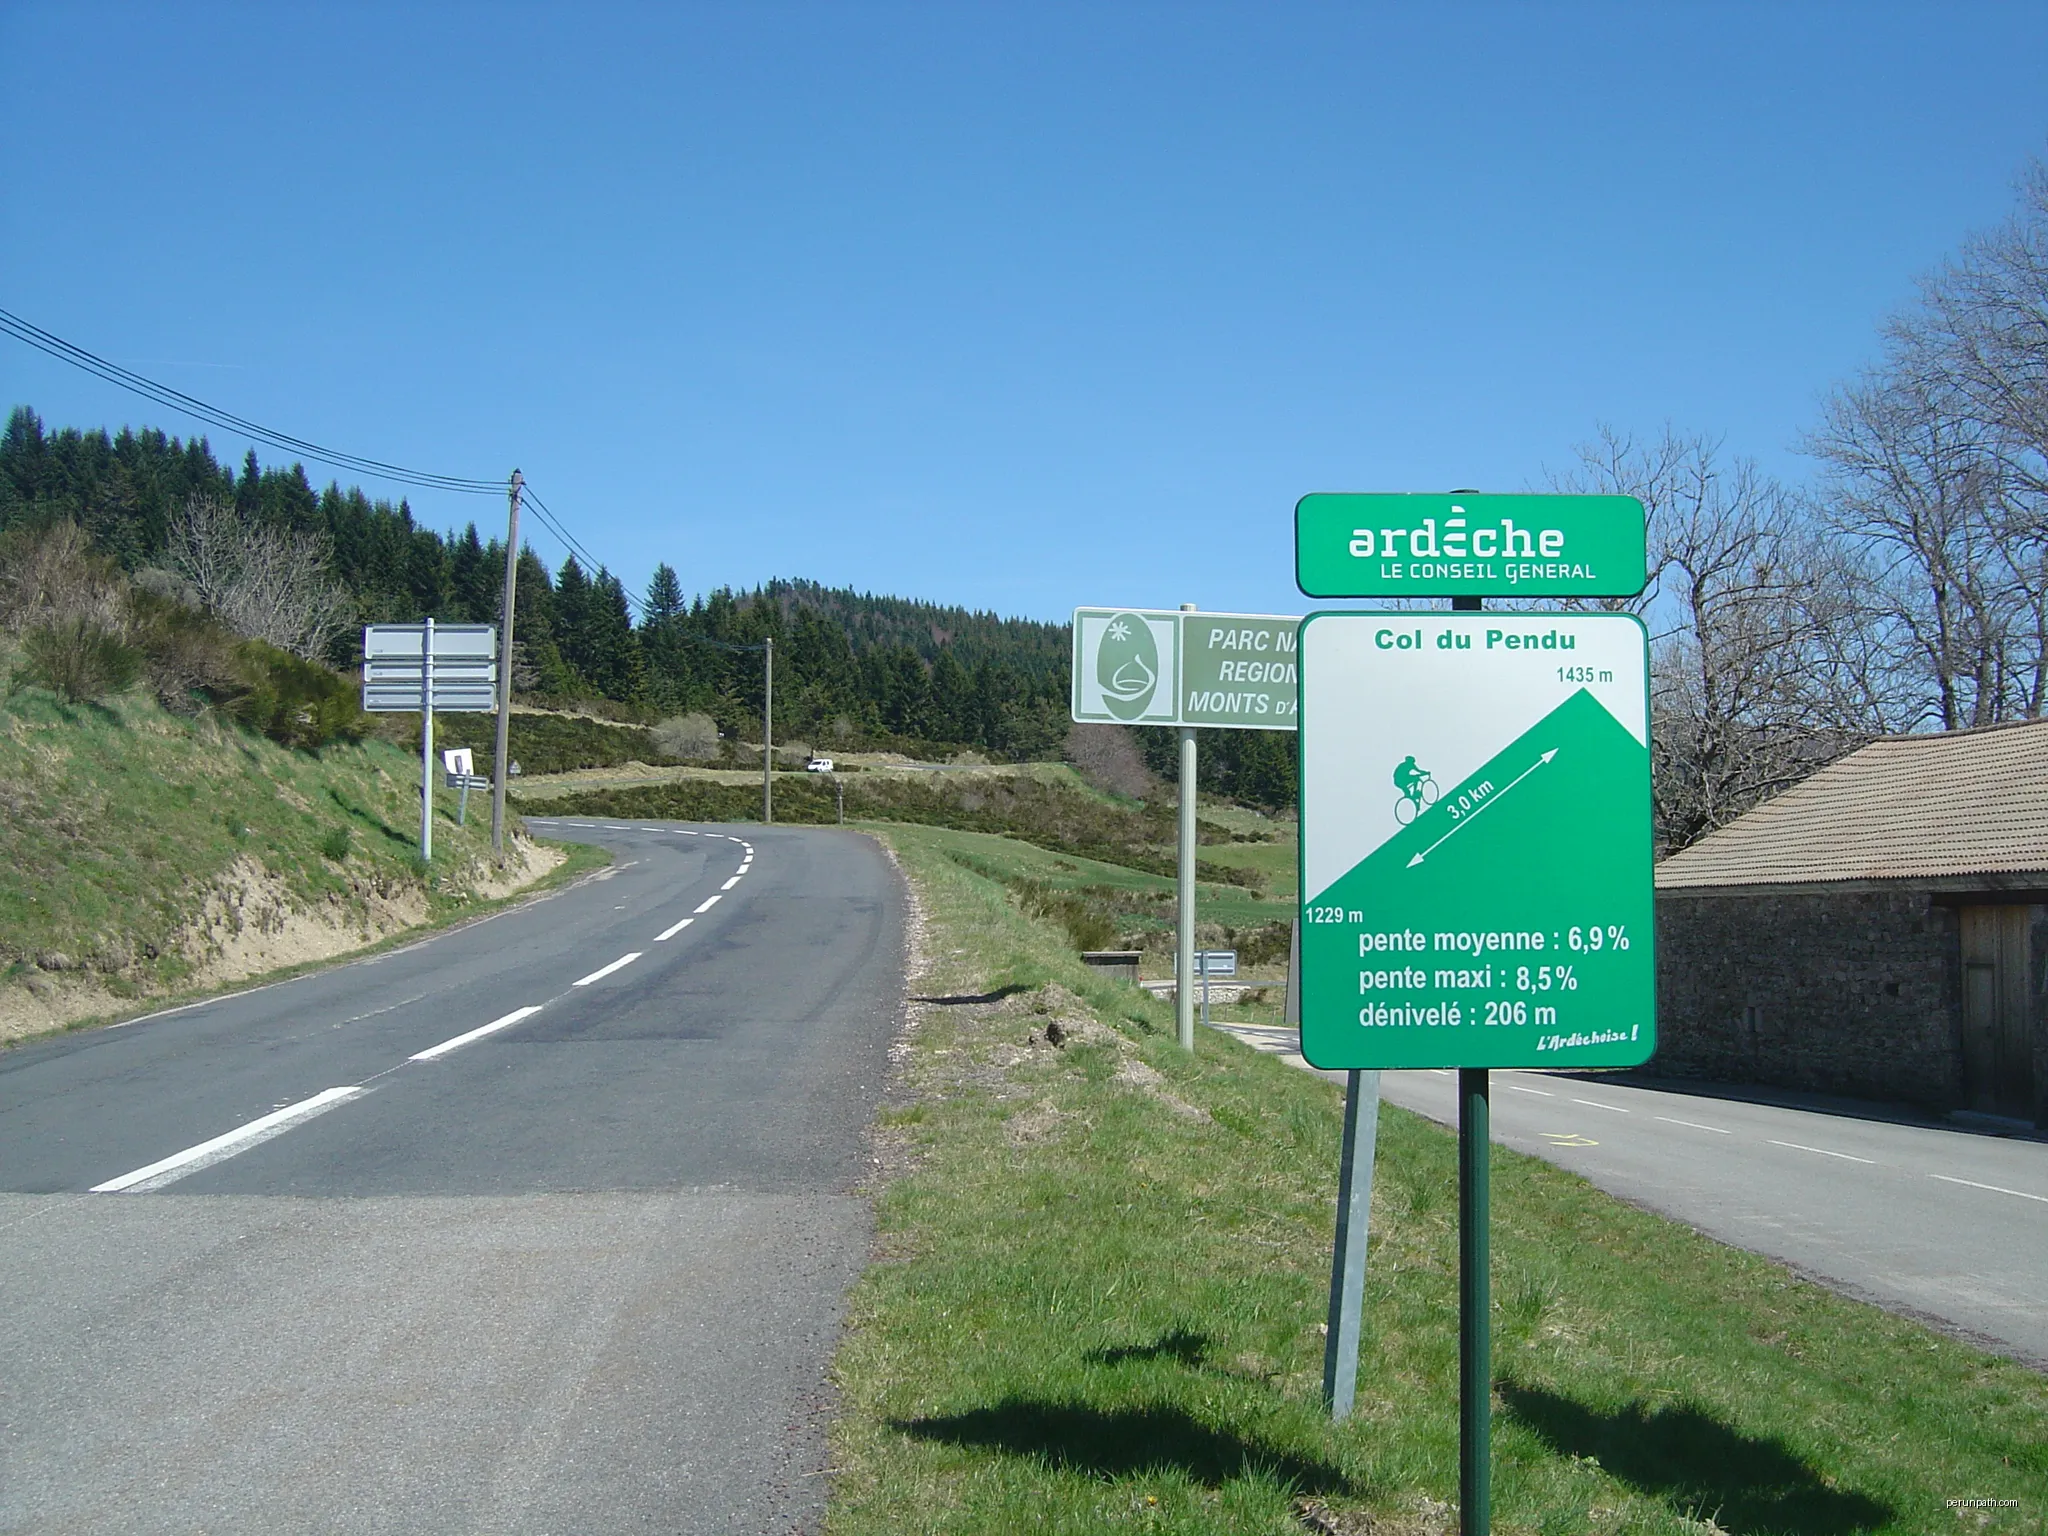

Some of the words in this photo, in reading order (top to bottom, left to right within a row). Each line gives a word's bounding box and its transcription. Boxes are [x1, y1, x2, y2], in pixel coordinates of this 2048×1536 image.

[1380, 563, 1403, 579] LE
[1409, 563, 1498, 579] CONSEIL
[1504, 563, 1597, 585] GENERAL
[1208, 628, 1270, 652] PARC
[1374, 628, 1422, 650] Col
[1436, 629, 1472, 650] du
[1485, 629, 1576, 650] Pendu
[1556, 667, 1594, 683] 1435
[1599, 670, 1613, 683] m
[1188, 691, 1269, 715] MONTS
[1446, 796, 1471, 819] 3,0
[1467, 780, 1495, 803] km
[1305, 907, 1344, 924] 1229
[1348, 910, 1364, 924] m
[1358, 928, 1427, 957] pente
[1433, 930, 1545, 957] moyenne
[1358, 966, 1427, 994] pente
[1434, 964, 1492, 989] maxi
[1358, 1001, 1462, 1027] dénivelé
[1484, 1001, 1528, 1026] 206
[1534, 1007, 1557, 1026] m
